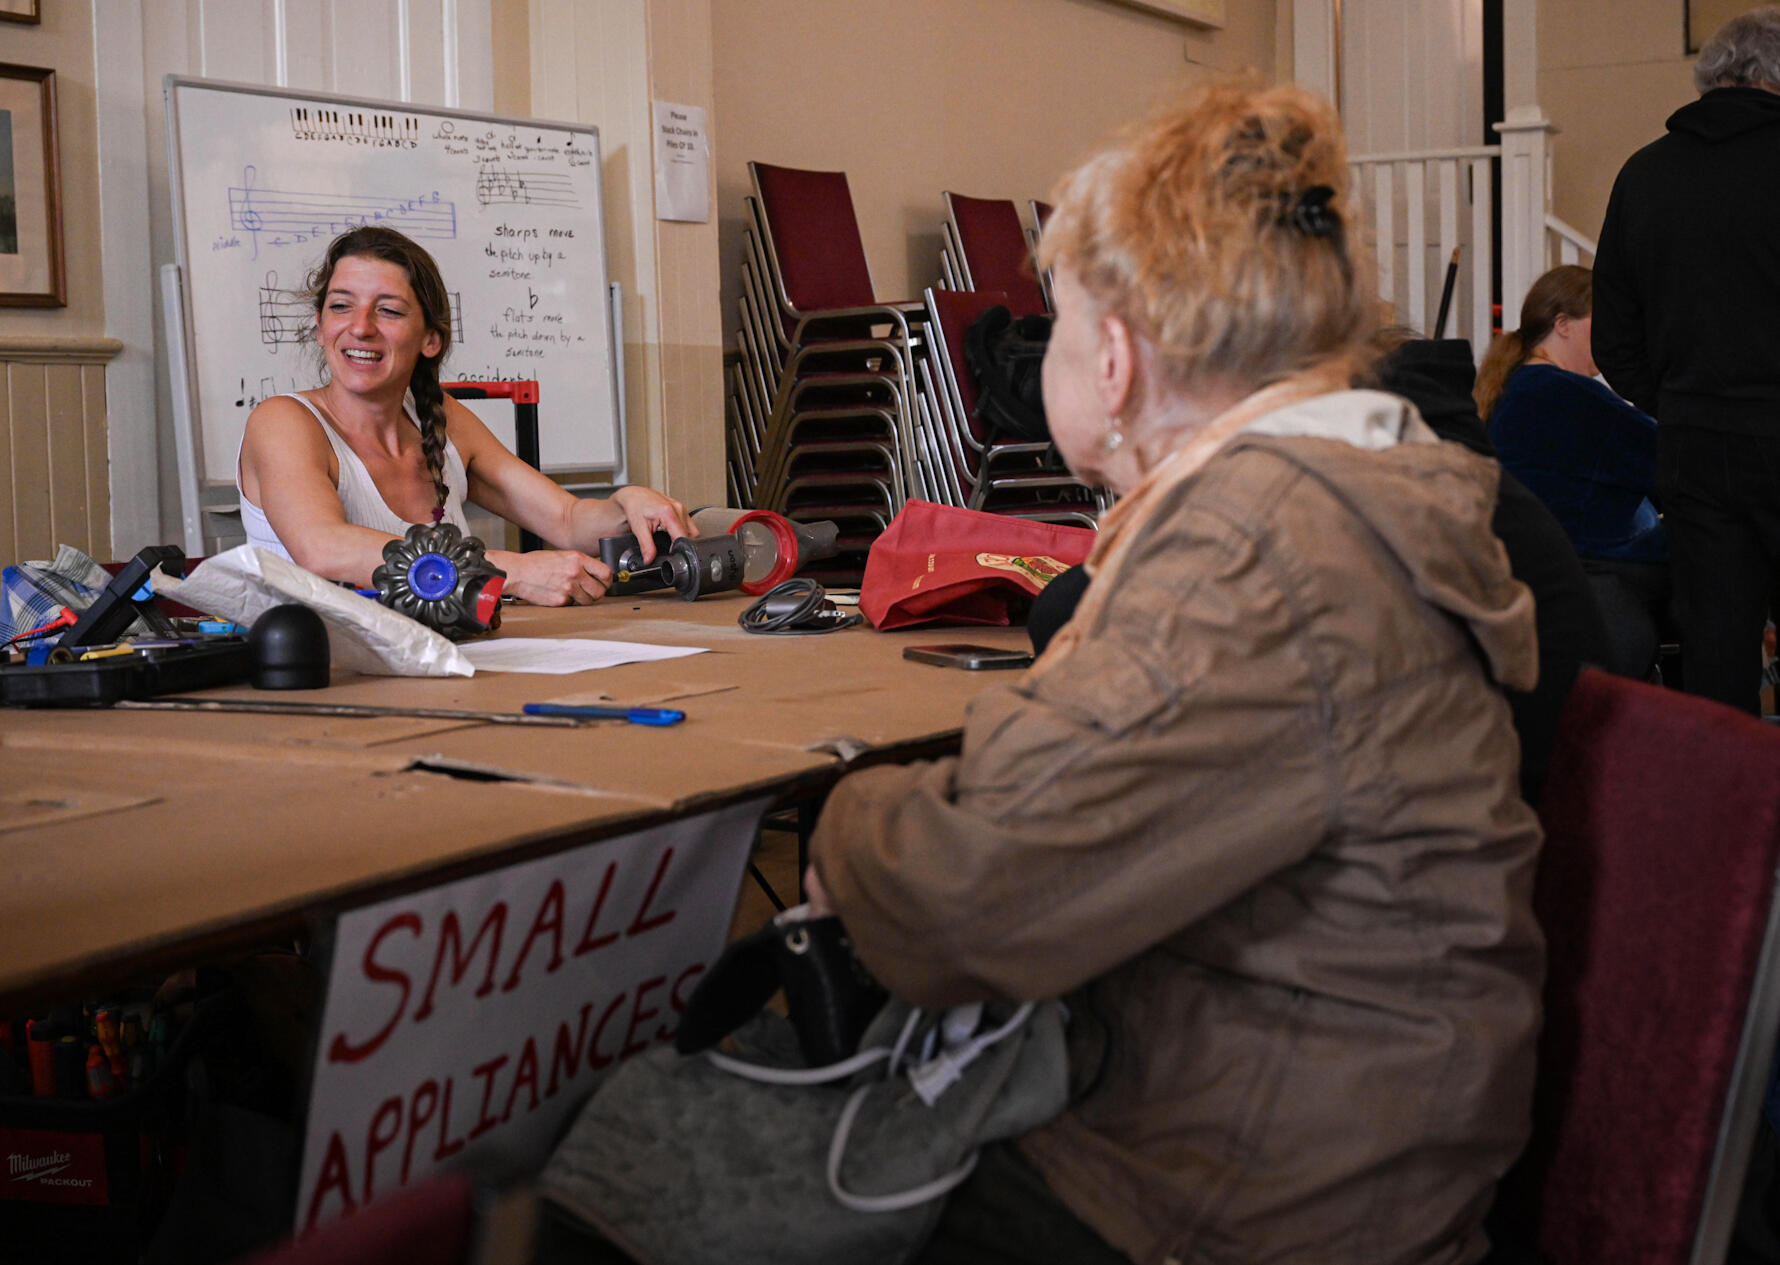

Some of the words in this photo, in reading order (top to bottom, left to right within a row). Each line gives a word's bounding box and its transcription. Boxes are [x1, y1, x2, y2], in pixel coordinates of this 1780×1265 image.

[494, 223, 538, 242] sharps
[549, 228, 575, 239] move
[501, 249, 524, 264] pitch
[528, 251, 540, 265] up
[542, 248, 552, 268] by
[489, 268, 532, 281] semitone
[503, 307, 535, 323] flats
[507, 328, 529, 342] pitch
[560, 329, 571, 348] by
[328, 846, 677, 1065] SMALL
[304, 963, 706, 1232] APPLIANCES
[7, 1150, 71, 1175] Milwaukee
[40, 1178, 93, 1188] PACKOUT
